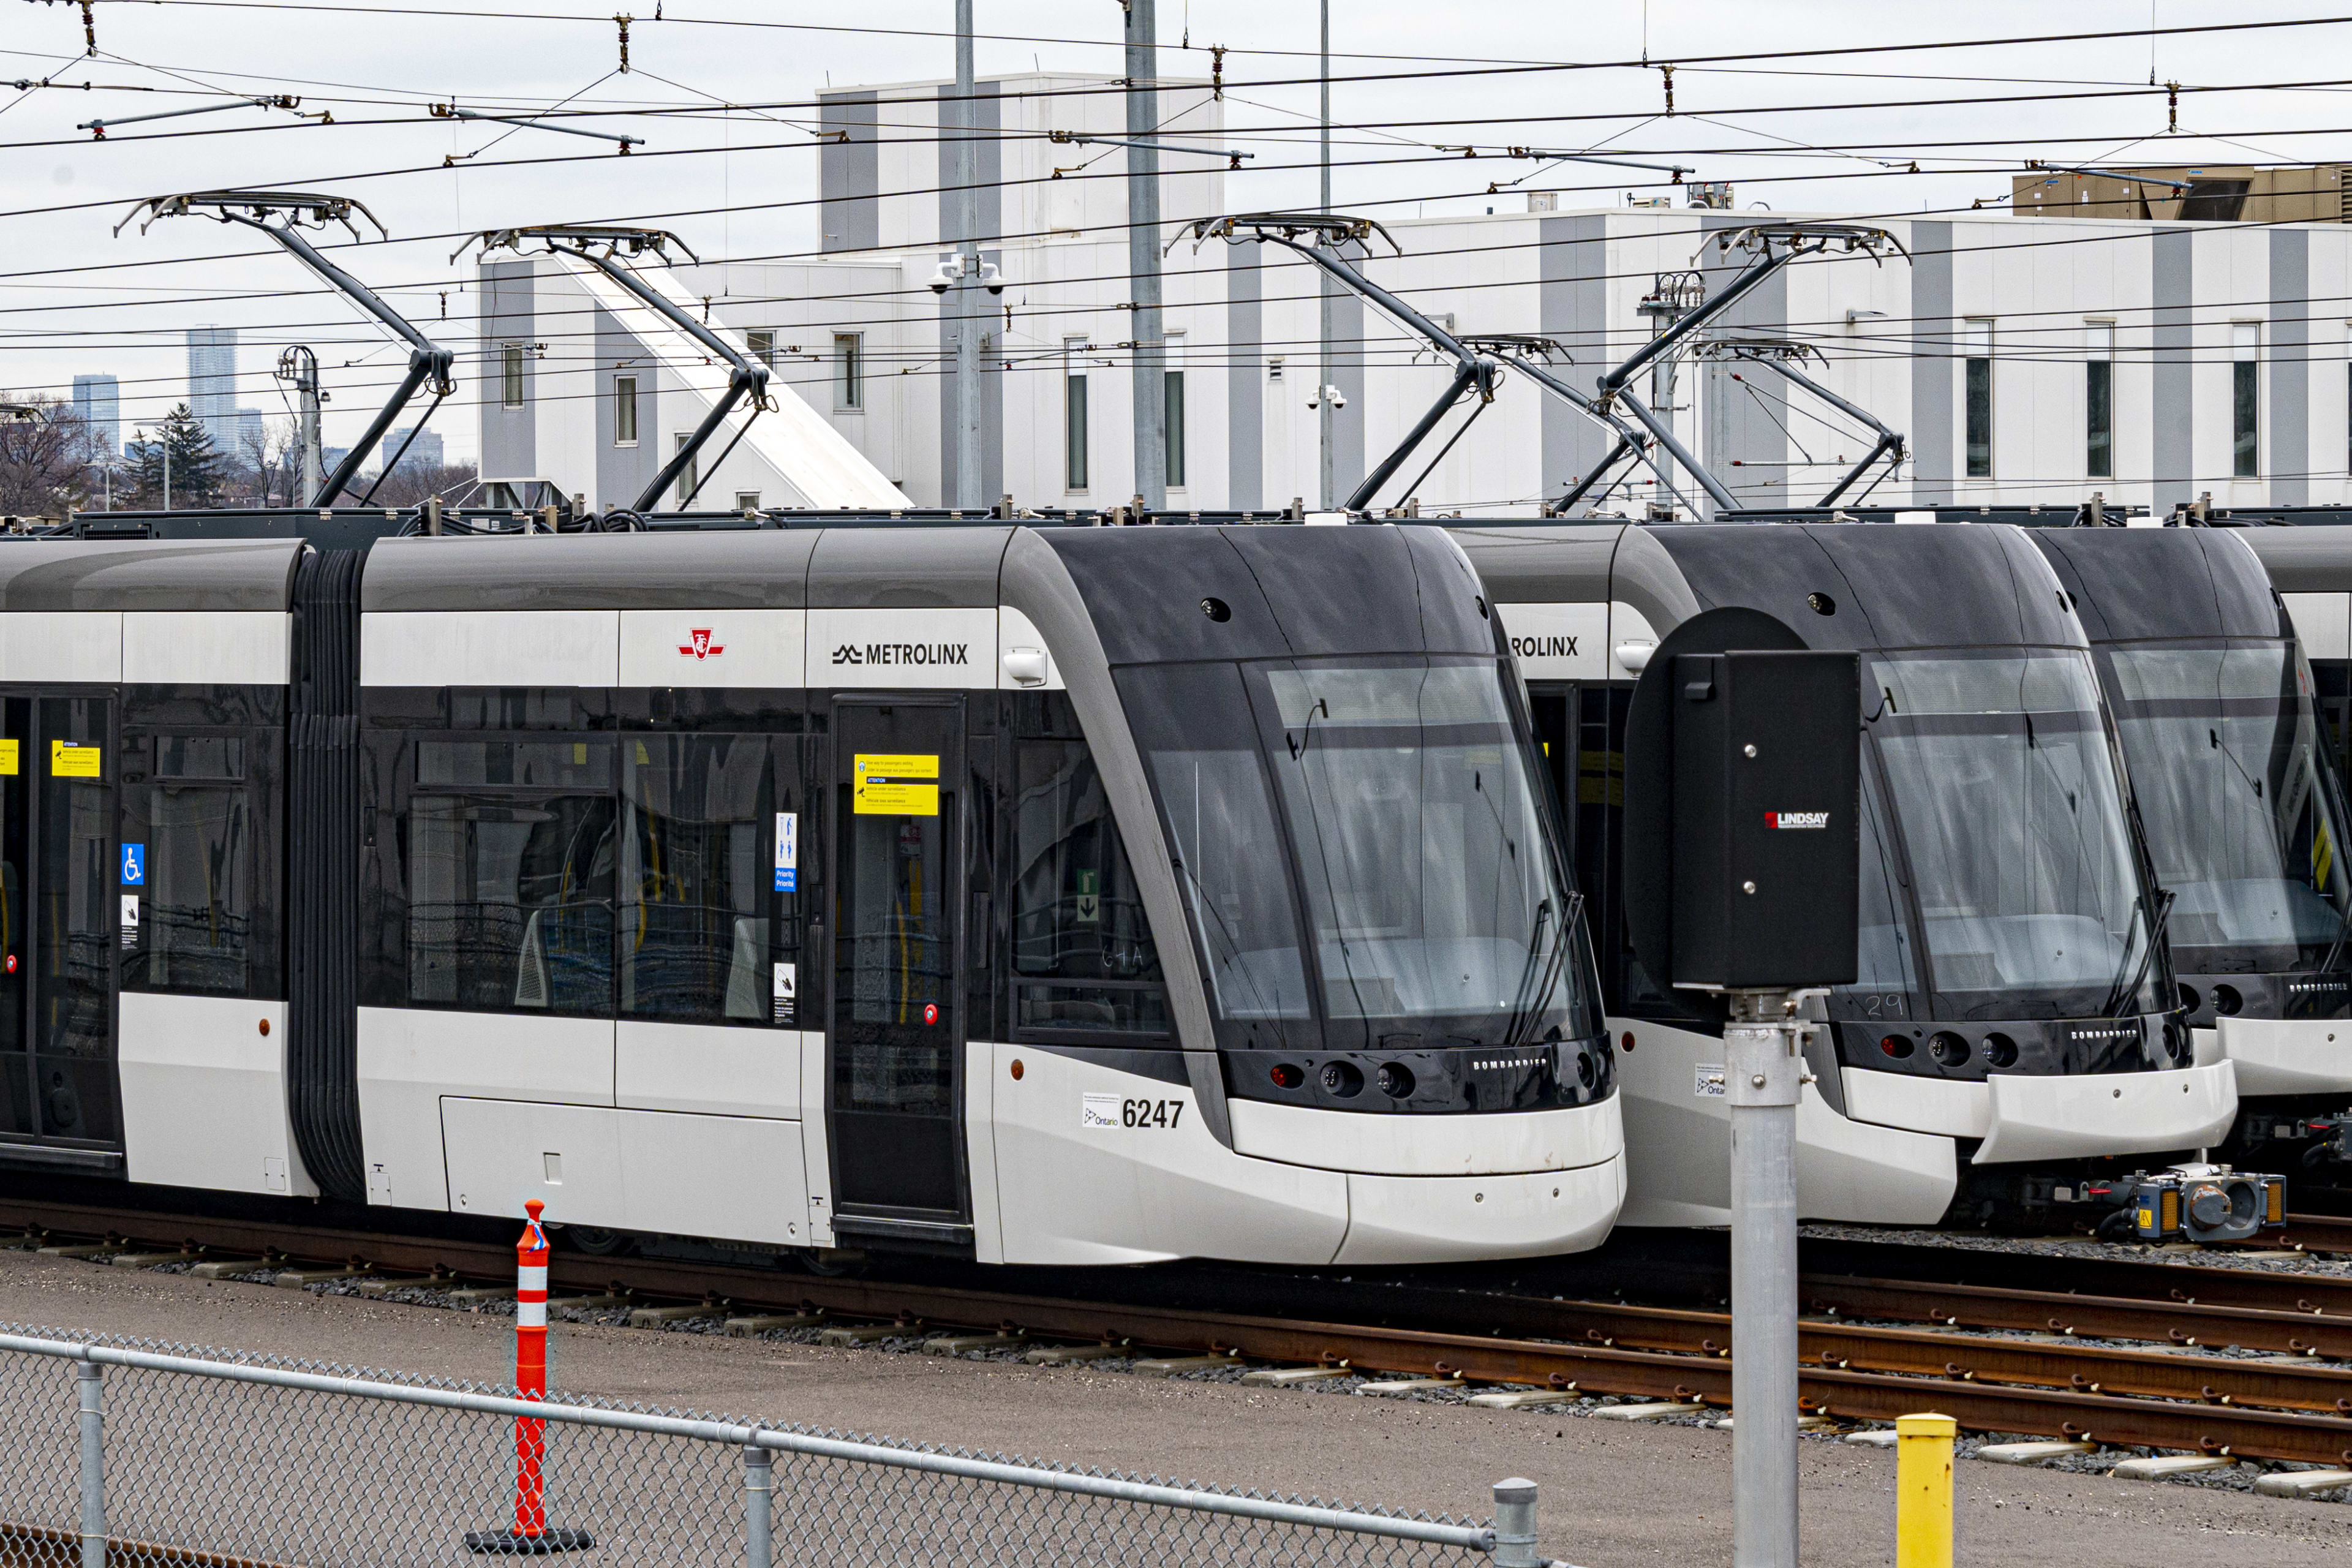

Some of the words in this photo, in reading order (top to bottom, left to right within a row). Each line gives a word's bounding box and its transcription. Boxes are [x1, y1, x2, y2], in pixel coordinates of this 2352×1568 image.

[1510, 636, 1578, 657] ROLINX
[866, 643, 968, 665] METROLINX
[1777, 813, 1829, 824] LINDSAY
[777, 870, 794, 879] Priority
[2289, 982, 2348, 992] BOMBARDIER
[1866, 993, 1903, 1016] 29
[2071, 1030, 2137, 1039] BOMBARDIER
[1473, 1058, 1547, 1071] BOMBARDIER
[1123, 1099, 1185, 1129] 6247
[1095, 1117, 1118, 1126] Ontario
